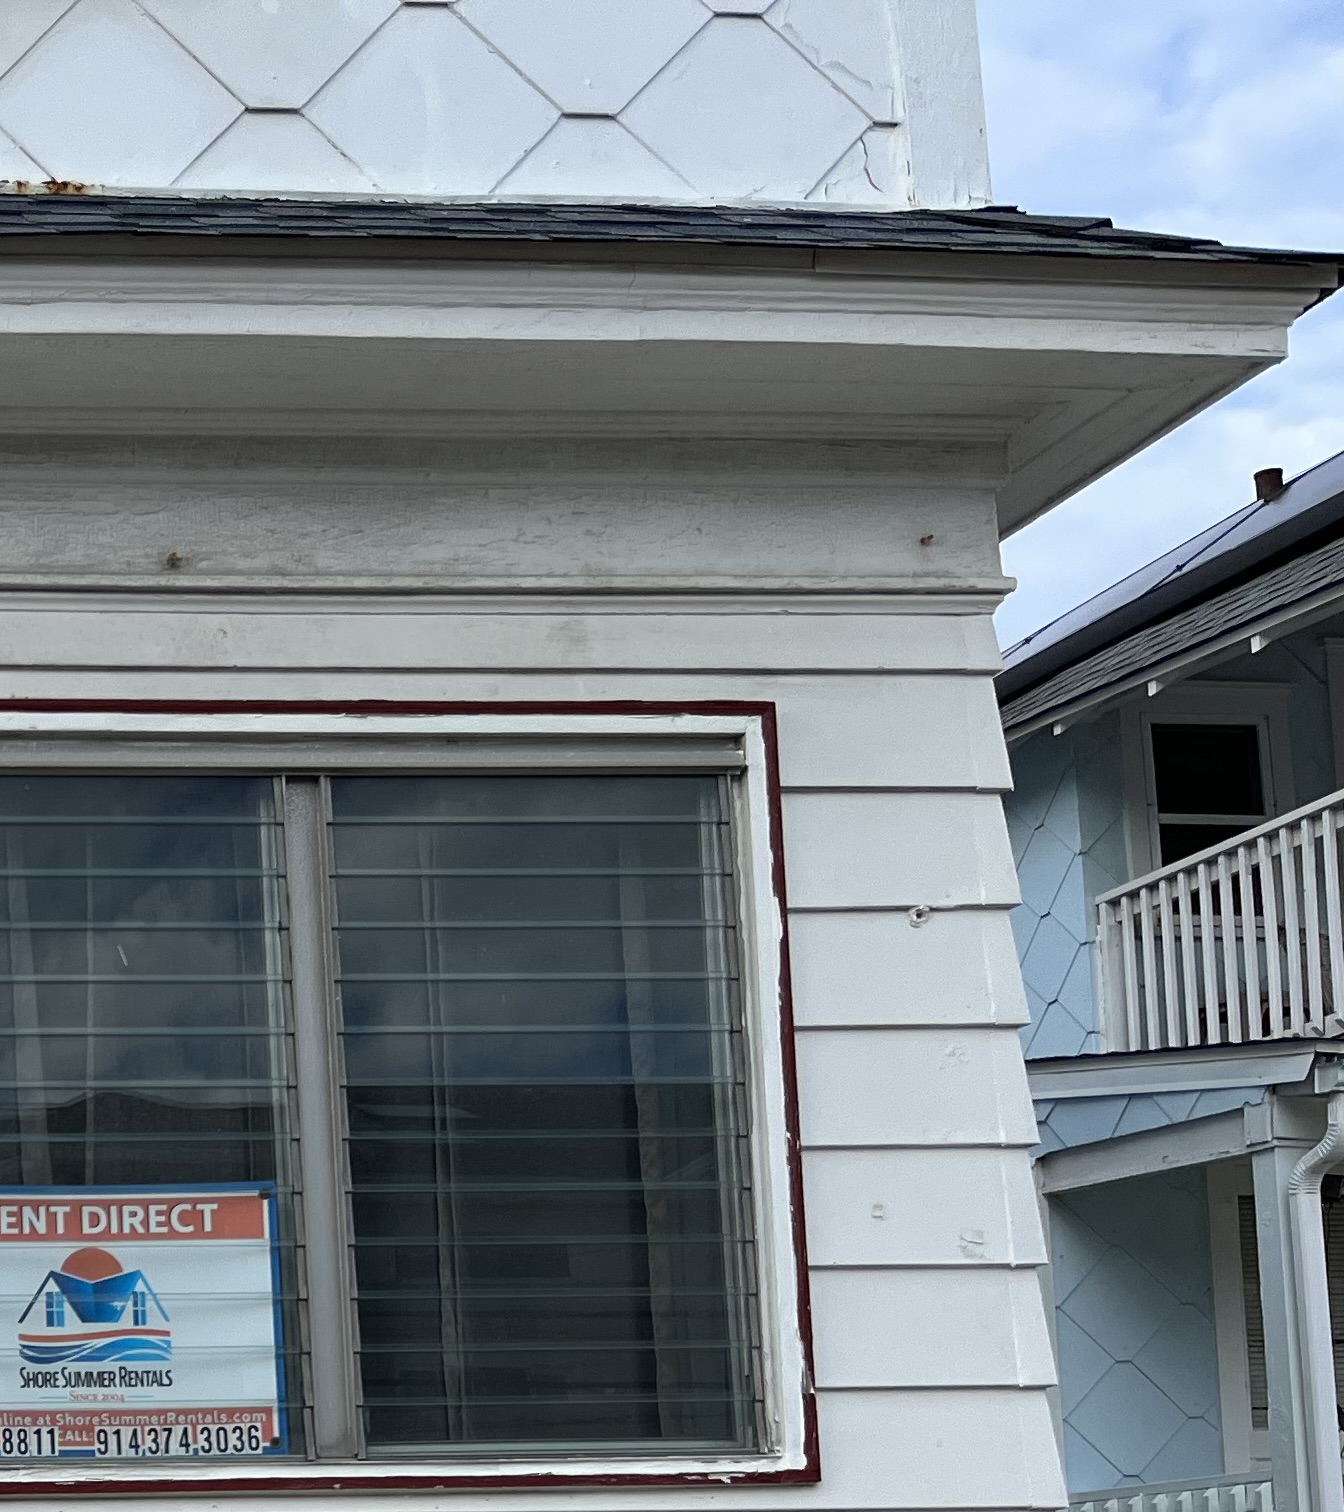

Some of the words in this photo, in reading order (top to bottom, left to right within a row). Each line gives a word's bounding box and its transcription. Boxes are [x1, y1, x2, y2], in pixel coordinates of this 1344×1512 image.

[81, 1203, 219, 1234] DIRECT
[19, 1366, 60, 1388] SHORE
[62, 1366, 117, 1388] SUMMER
[118, 1366, 173, 1388] RENTALS
[68, 1390, 98, 1402] SINCE
[36, 1414, 51, 1426] at
[56, 1410, 267, 1426] ShoreSummerRentals.com
[2, 1427, 56, 1455] 8811
[96, 1428, 141, 1456] 914
[147, 1427, 191, 1454] 374
[199, 1424, 260, 1453] 3036
